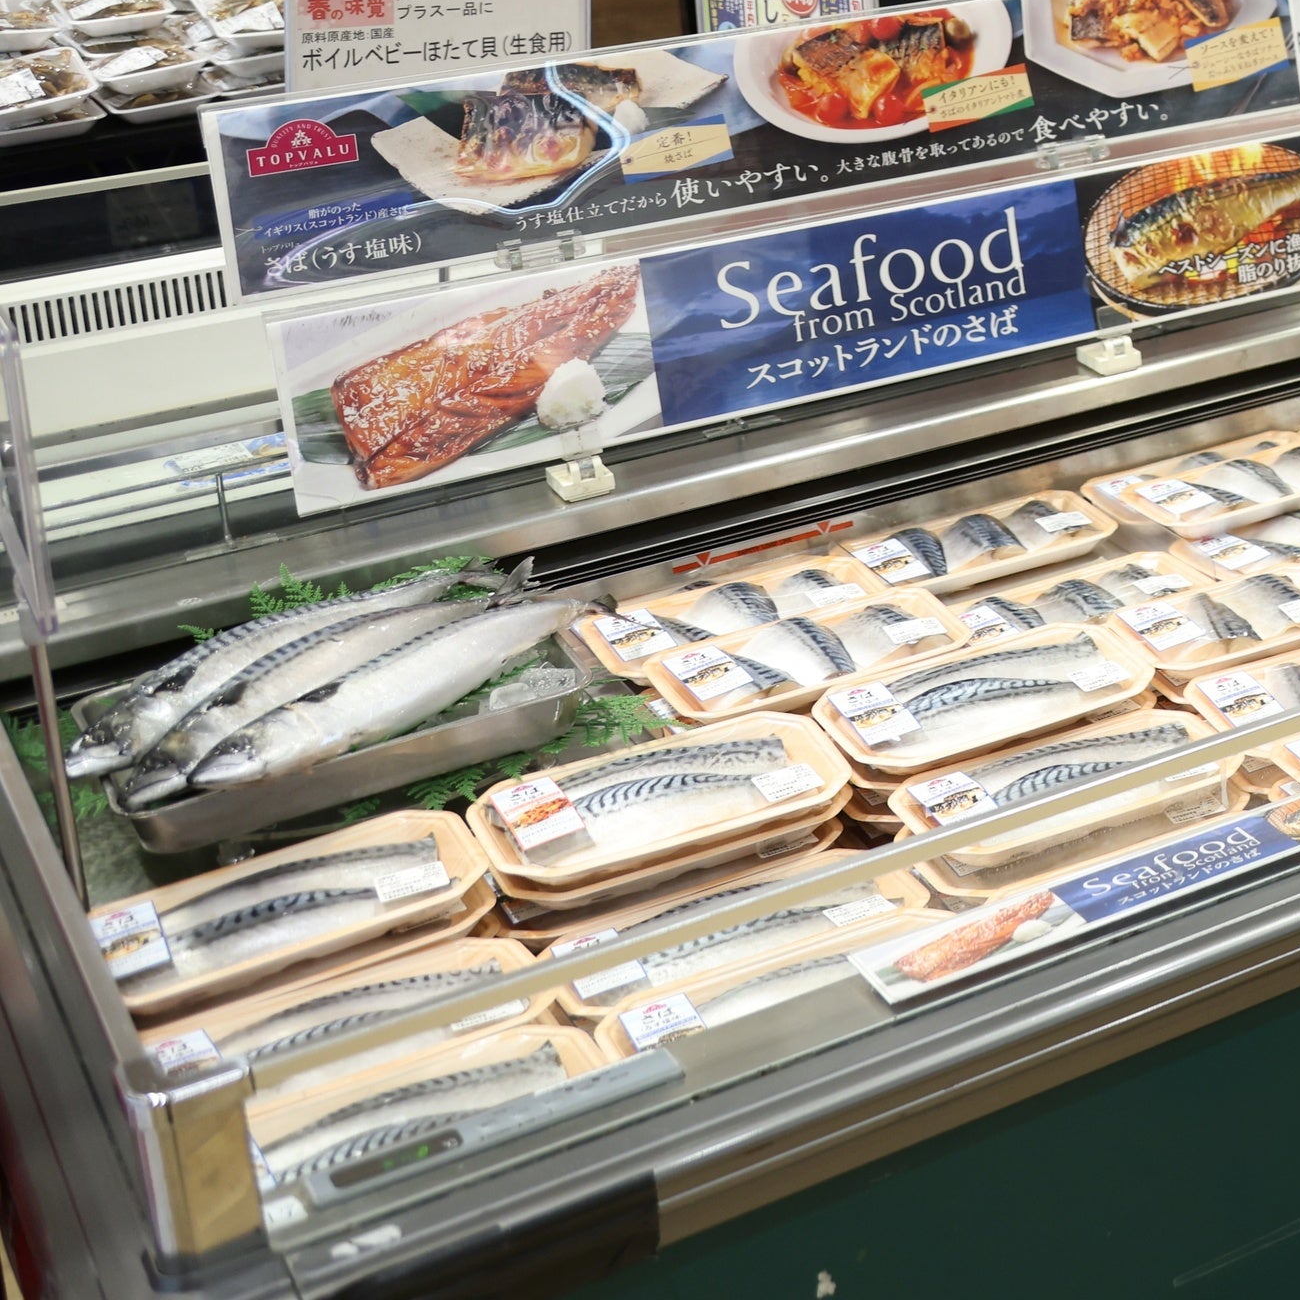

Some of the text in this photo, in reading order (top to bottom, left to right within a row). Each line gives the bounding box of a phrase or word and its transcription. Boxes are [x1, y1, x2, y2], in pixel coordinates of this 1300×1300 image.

[396, 1, 494, 20] プラス一品に
[938, 75, 1016, 104] イタリアンにも!
[255, 144, 351, 168] TOPVALU
[656, 130, 693, 149] 定番!
[663, 148, 694, 164] 焼さば
[308, 202, 362, 220] 脂がのった
[264, 231, 422, 277] さば(うす塩味)
[717, 206, 1024, 330] Seafood
[792, 266, 1027, 342] from Scotland
[746, 304, 1019, 390] スコットランドのさば
[1082, 826, 1255, 898] Seafood
[1117, 846, 1263, 906] スコットランドのさば
[1130, 836, 1262, 890] from Scotland
